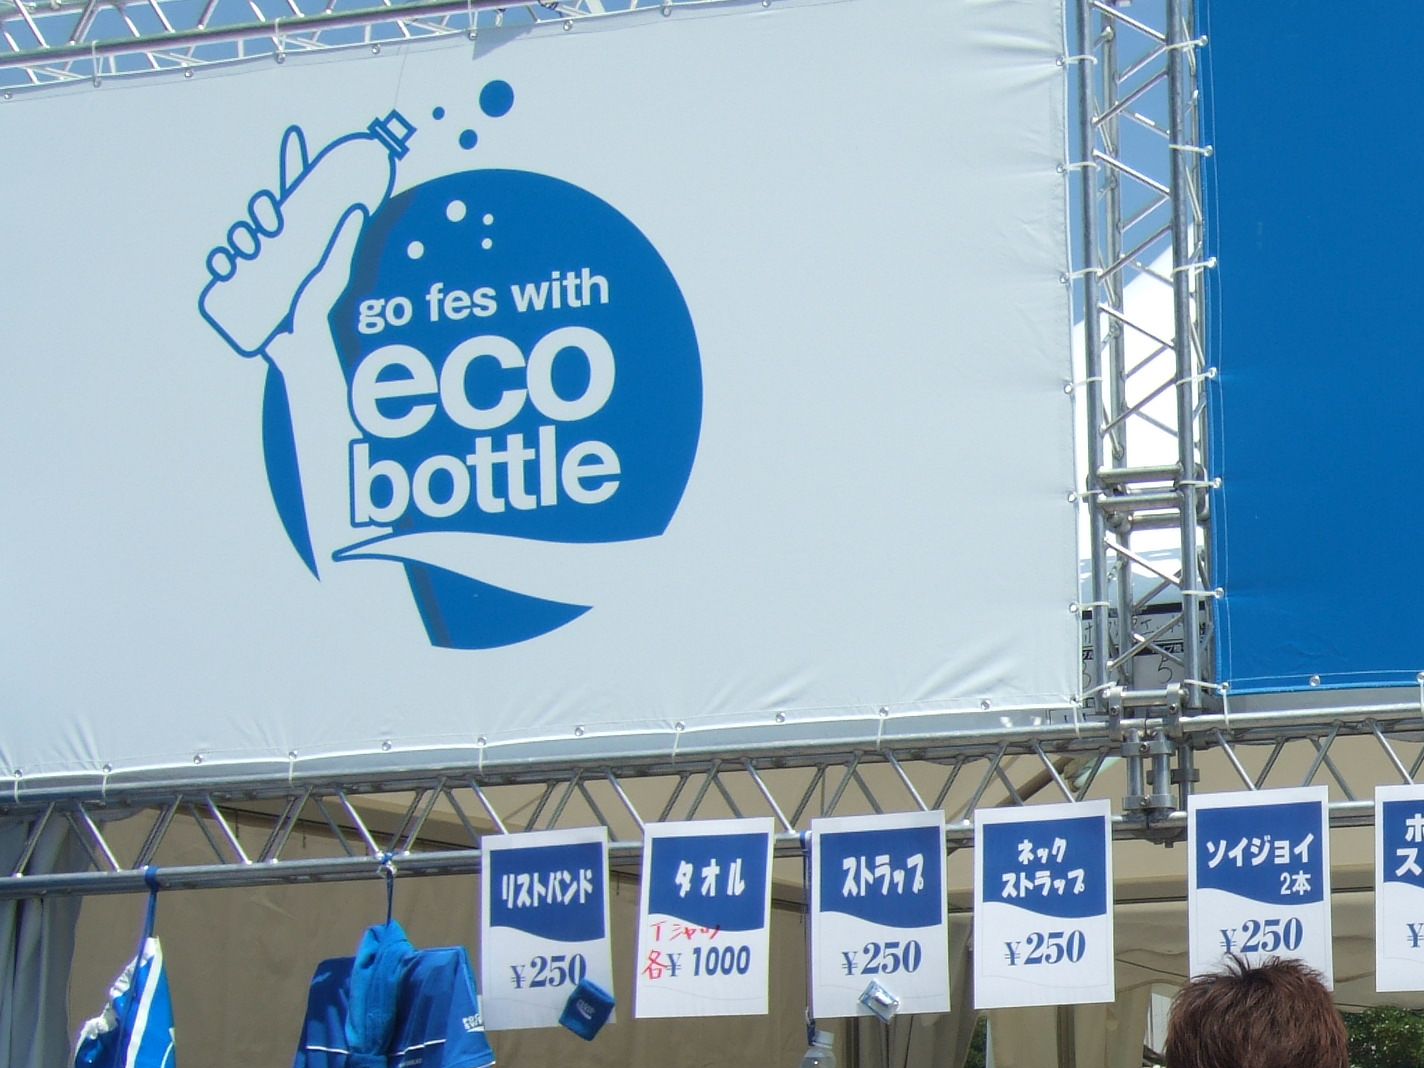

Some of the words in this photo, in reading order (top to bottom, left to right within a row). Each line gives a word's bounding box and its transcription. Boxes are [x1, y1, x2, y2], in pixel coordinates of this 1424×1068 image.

[358, 295, 413, 334] go
[426, 282, 498, 324] fes
[510, 267, 610, 313] with
[352, 325, 617, 439] eco
[354, 424, 622, 524] bottle
[1017, 837, 1068, 864] ネック
[1206, 833, 1315, 869] ソイジョイ
[502, 868, 593, 909] リストバンド
[675, 858, 746, 898] タオル
[842, 853, 925, 897] ストラップ
[1002, 869, 1086, 898] ストラップ
[1280, 869, 1312, 897] 2本
[842, 939, 923, 976] ¥250
[1004, 929, 1087, 967] ¥250
